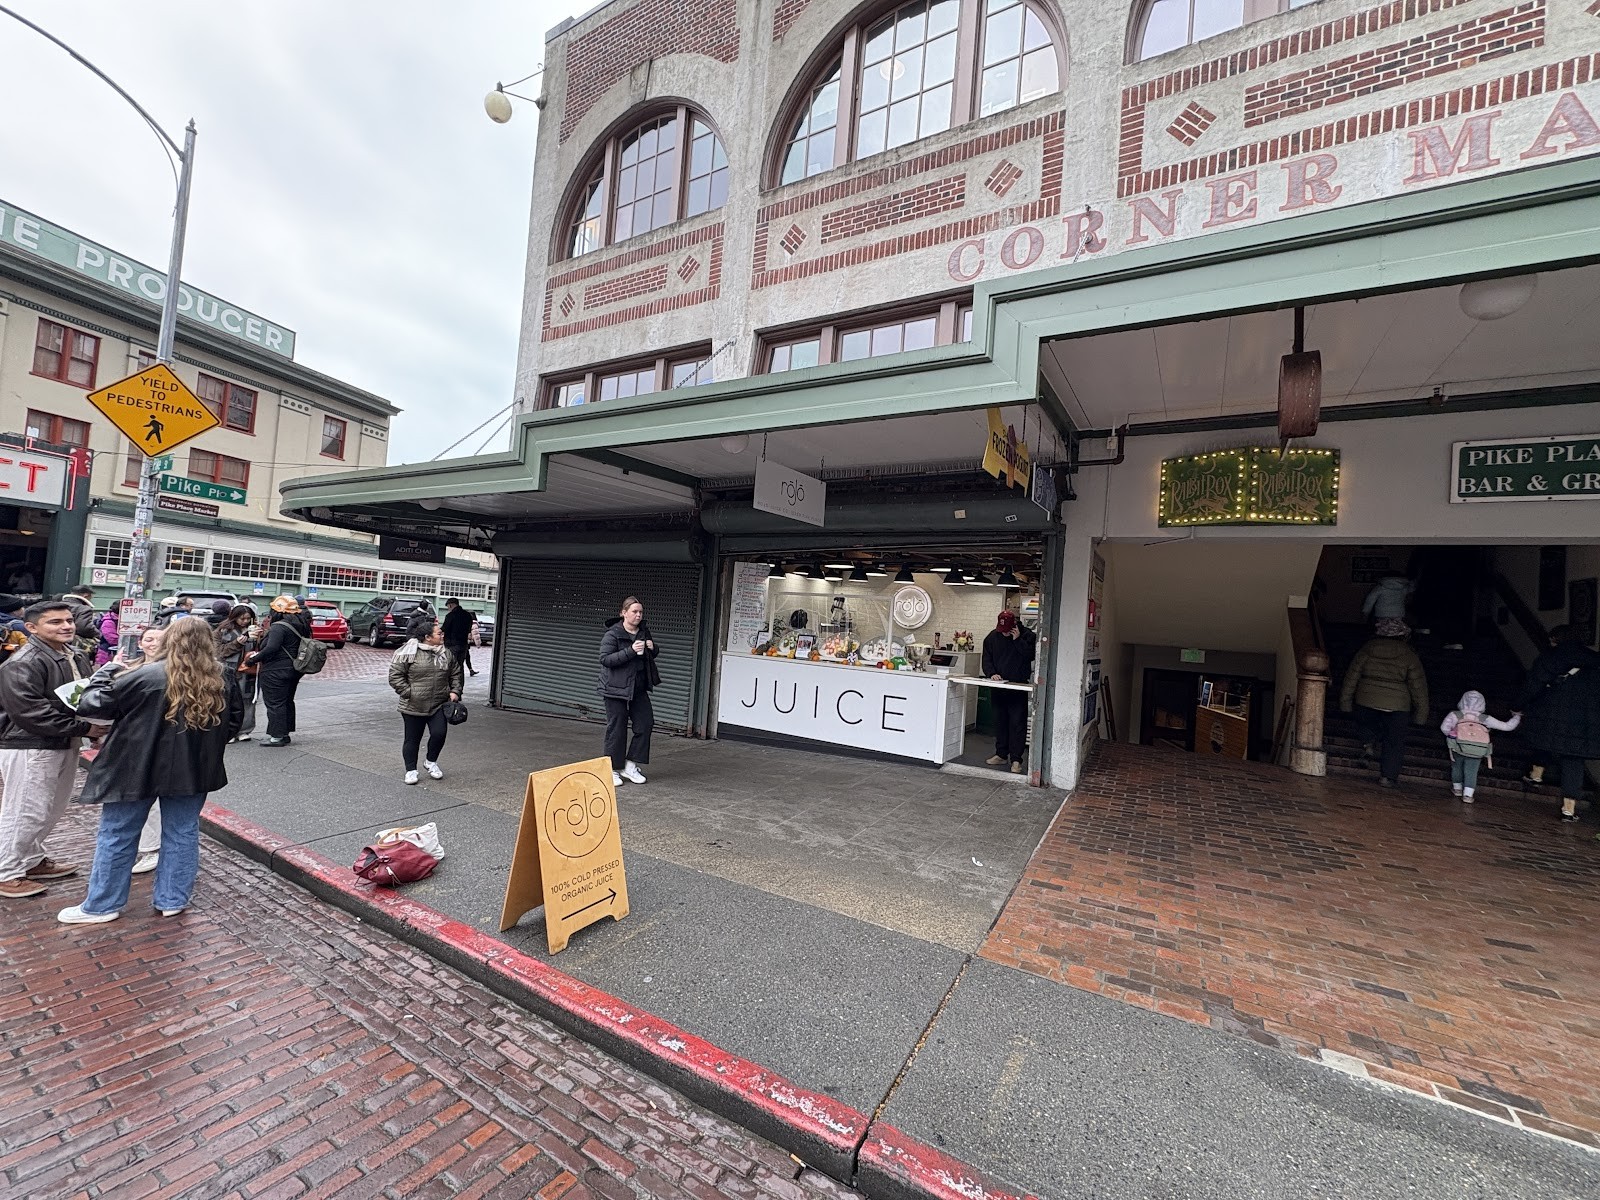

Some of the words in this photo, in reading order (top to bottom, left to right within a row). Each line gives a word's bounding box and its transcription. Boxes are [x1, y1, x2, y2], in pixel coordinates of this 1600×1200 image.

[947, 153, 1342, 282] CORNER
[1403, 92, 1600, 185] MA
[76, 242, 283, 350] PRODUCER
[141, 376, 178, 392] YIELD
[150, 390, 166, 401] TO
[106, 392, 202, 419] PEDESTRIANS
[1467, 447, 1533, 467] PIKE
[1546, 444, 1600, 463] PLA
[167, 476, 200, 495] Pike
[1459, 476, 1515, 494] BAR
[1527, 475, 1549, 491] &
[1562, 473, 1600, 491] GR
[176, 504, 194, 512] Place
[194, 507, 217, 516] Market
[732, 620, 740, 645] COFFEE
[741, 677, 908, 733] JUICE
[551, 881, 571, 894] 100%
[571, 871, 592, 886] COLD
[592, 859, 620, 876] PRESSED
[561, 882, 594, 902] ORGANIC
[594, 872, 614, 887] JUICE
